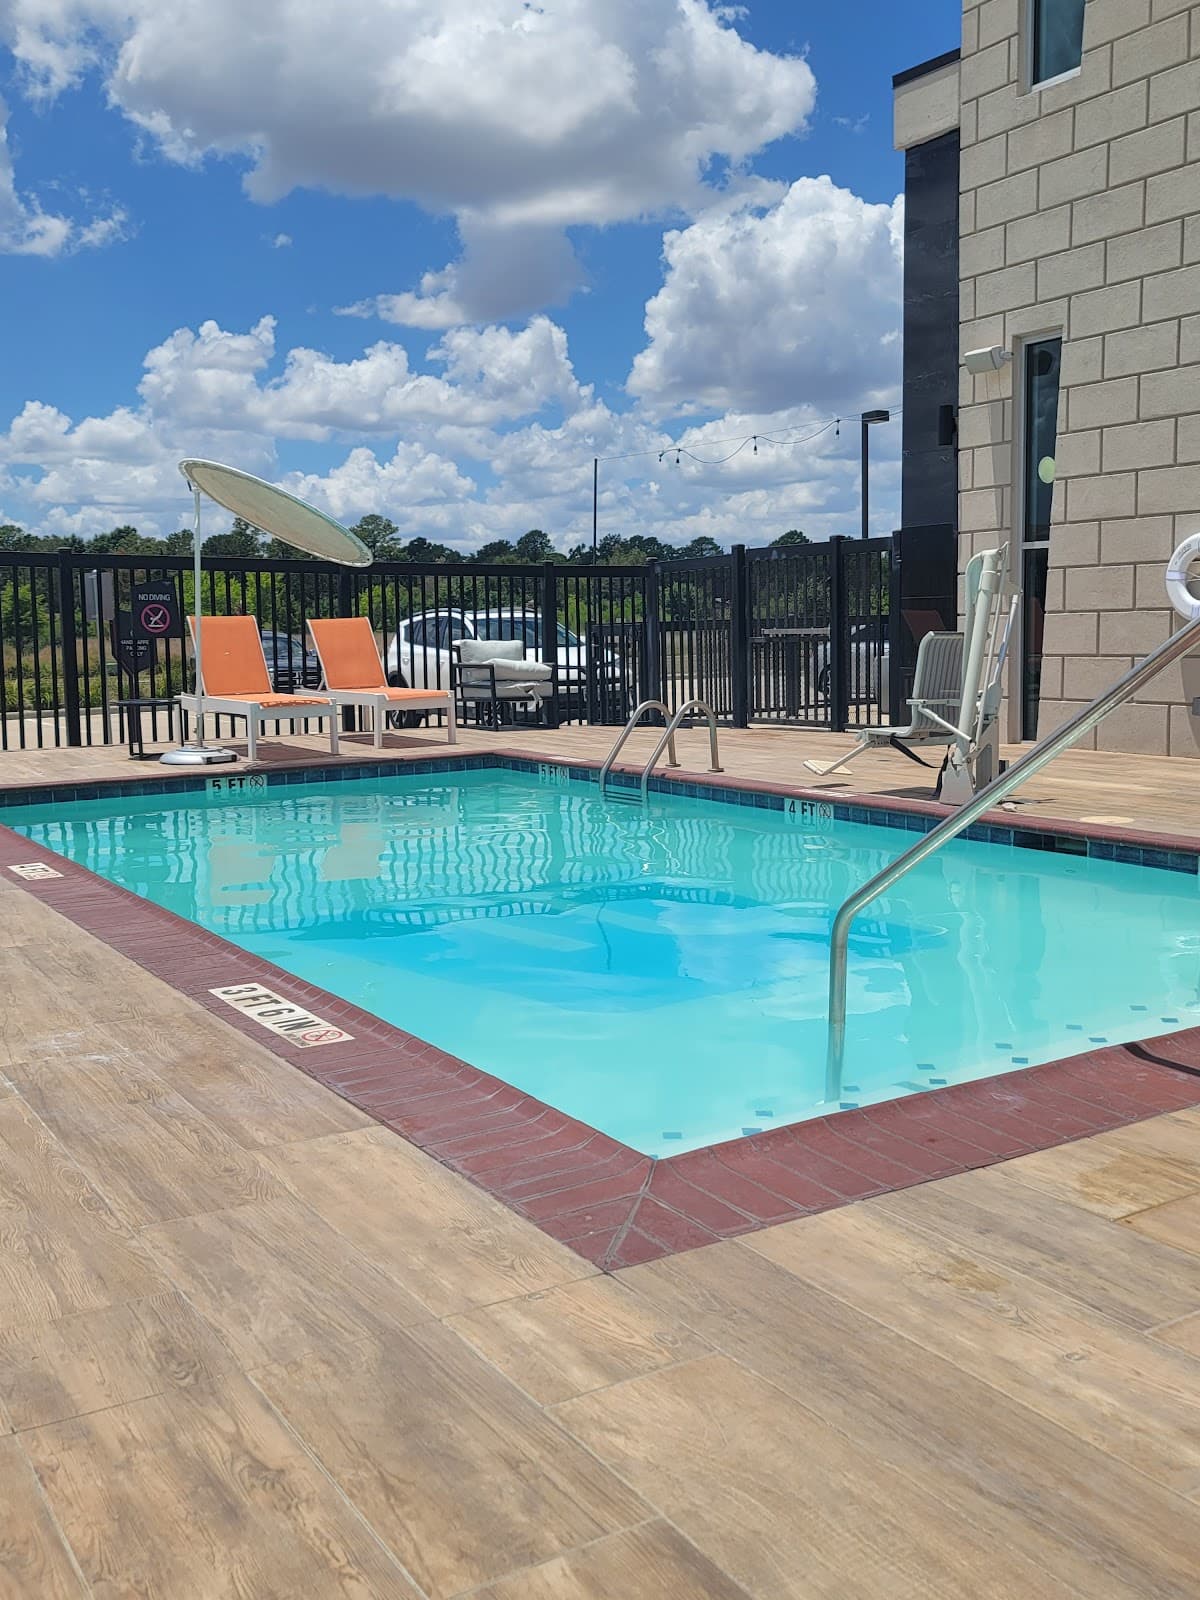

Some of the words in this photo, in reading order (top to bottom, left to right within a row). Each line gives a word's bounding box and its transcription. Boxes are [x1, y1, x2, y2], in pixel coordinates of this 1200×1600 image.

[138, 593, 148, 601] NO
[149, 593, 171, 601] DIVING
[541, 764, 546, 776] 5
[549, 765, 558, 777] FT
[212, 779, 222, 790] 5
[228, 777, 246, 789] FT
[789, 800, 796, 813] 4
[801, 801, 816, 817] FT
[221, 986, 258, 996] 3
[233, 993, 283, 1009] FT
[257, 1007, 296, 1018] 6
[271, 1016, 321, 1032] IN
